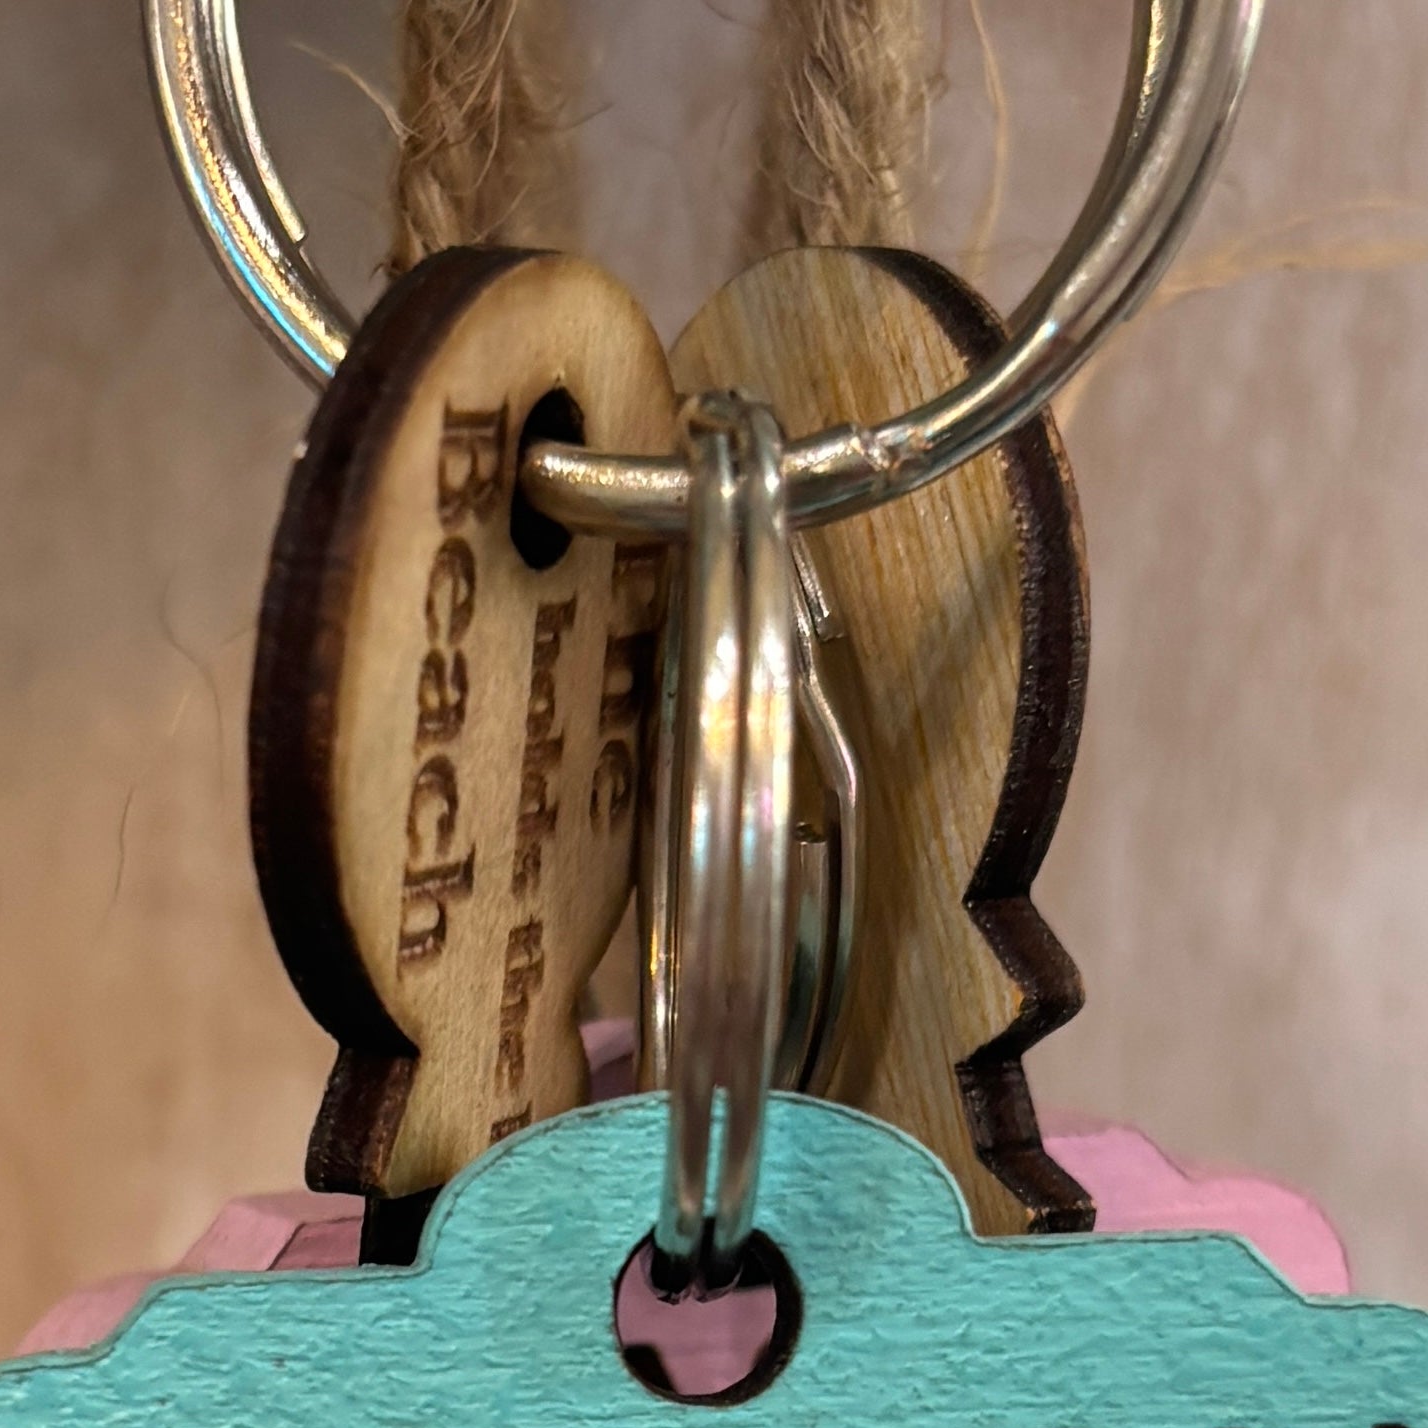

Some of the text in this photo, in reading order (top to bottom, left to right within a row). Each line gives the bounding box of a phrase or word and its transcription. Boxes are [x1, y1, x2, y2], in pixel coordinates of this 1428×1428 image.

[396, 395, 511, 980] Beach
[511, 592, 575, 900] holds
[492, 915, 546, 1094] the
